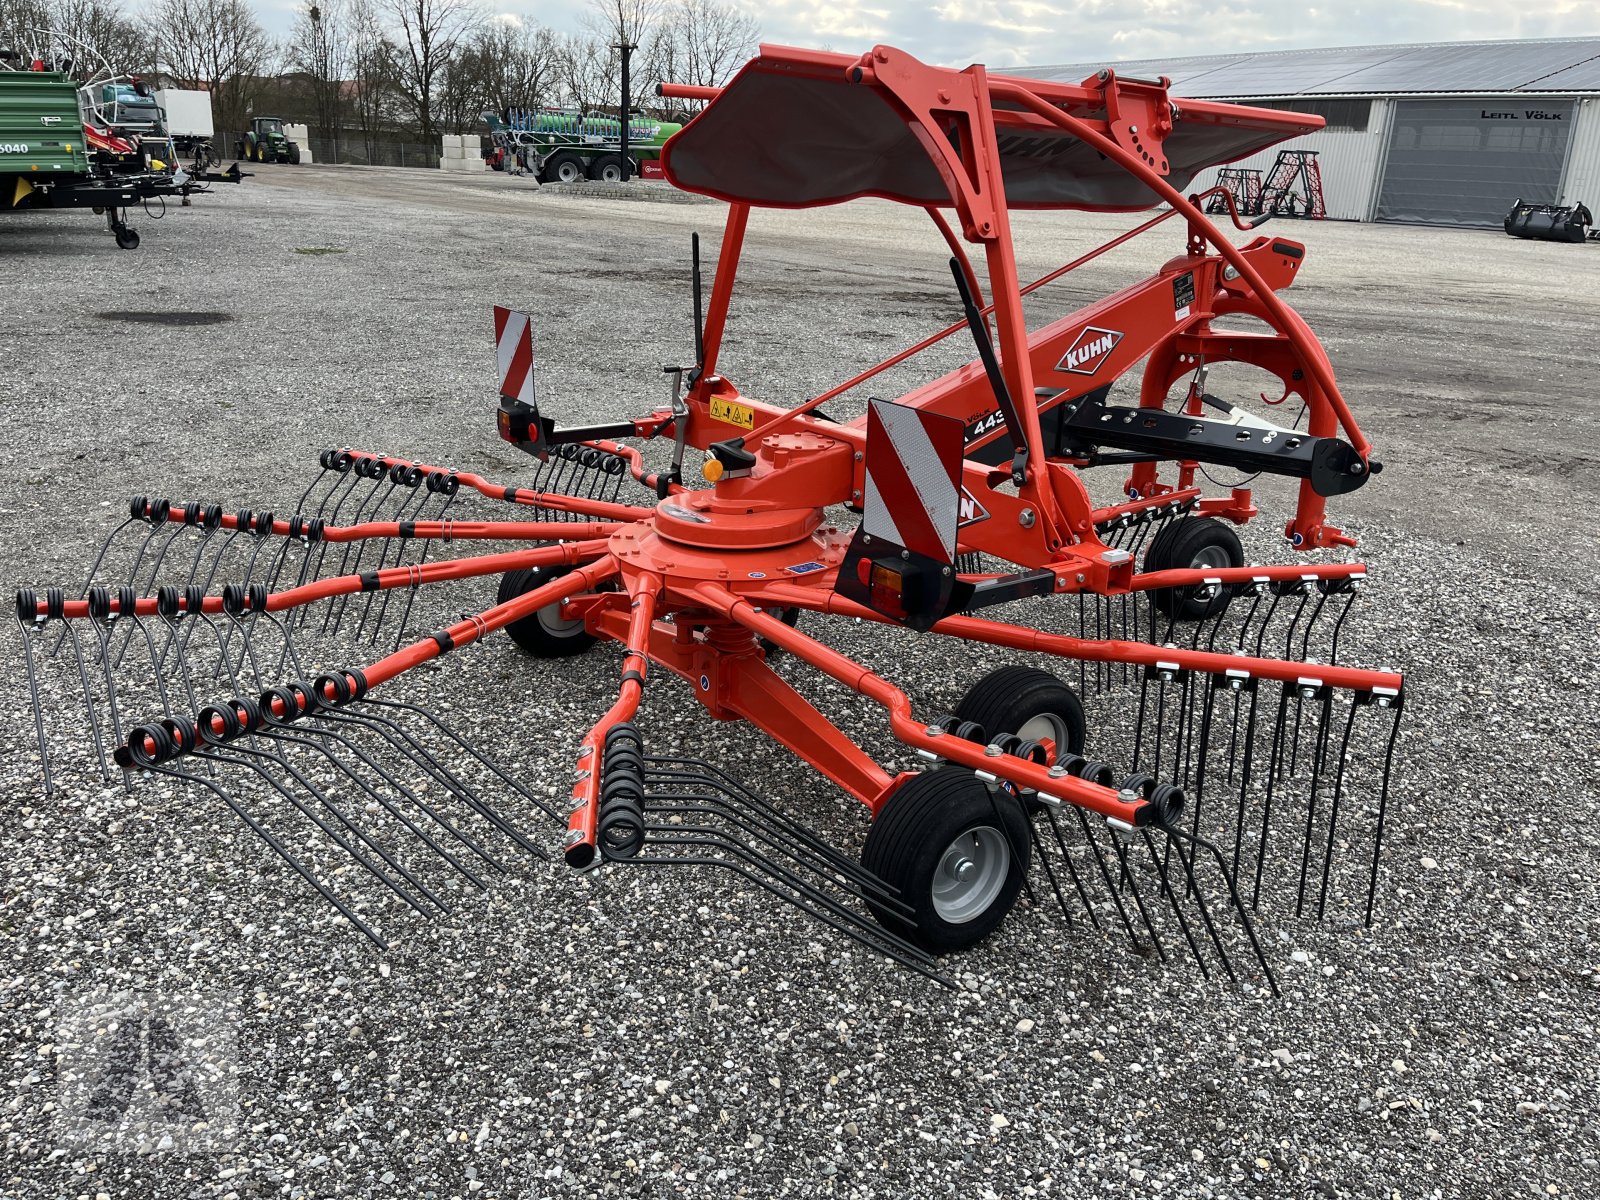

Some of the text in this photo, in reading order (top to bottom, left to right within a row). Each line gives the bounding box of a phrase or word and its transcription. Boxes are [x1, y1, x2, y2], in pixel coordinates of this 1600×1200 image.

[1481, 110, 1562, 120] LEITL VÖLK
[1066, 333, 1113, 369] KUHN
